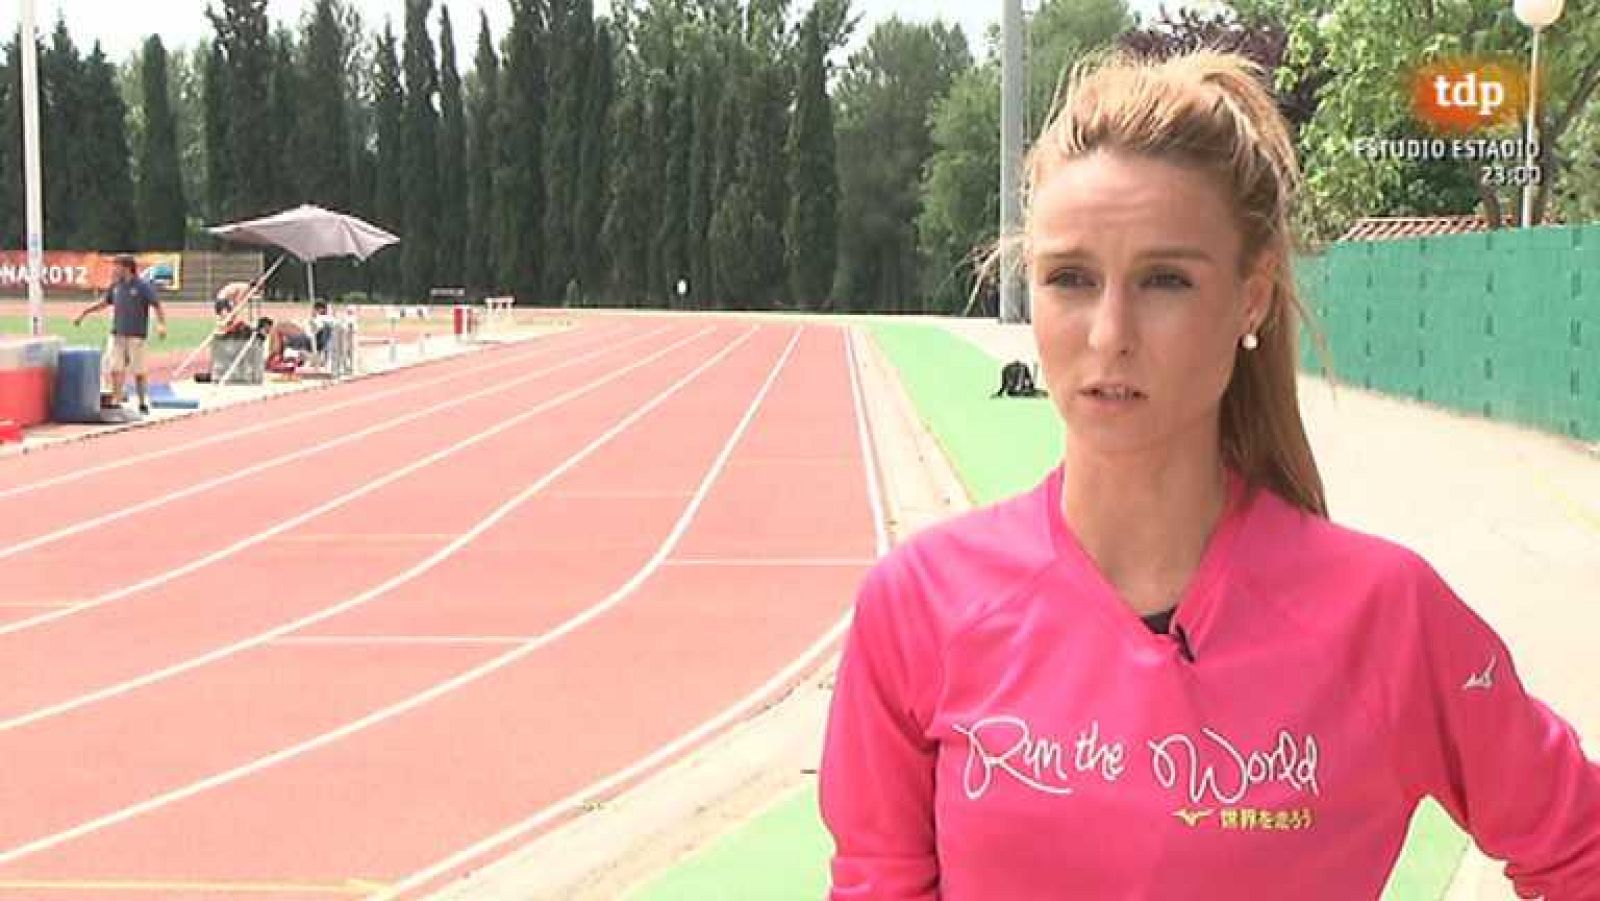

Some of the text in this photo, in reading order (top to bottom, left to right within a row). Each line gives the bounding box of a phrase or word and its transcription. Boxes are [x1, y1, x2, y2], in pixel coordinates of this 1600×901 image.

[952, 714, 1320, 804] Run the World
